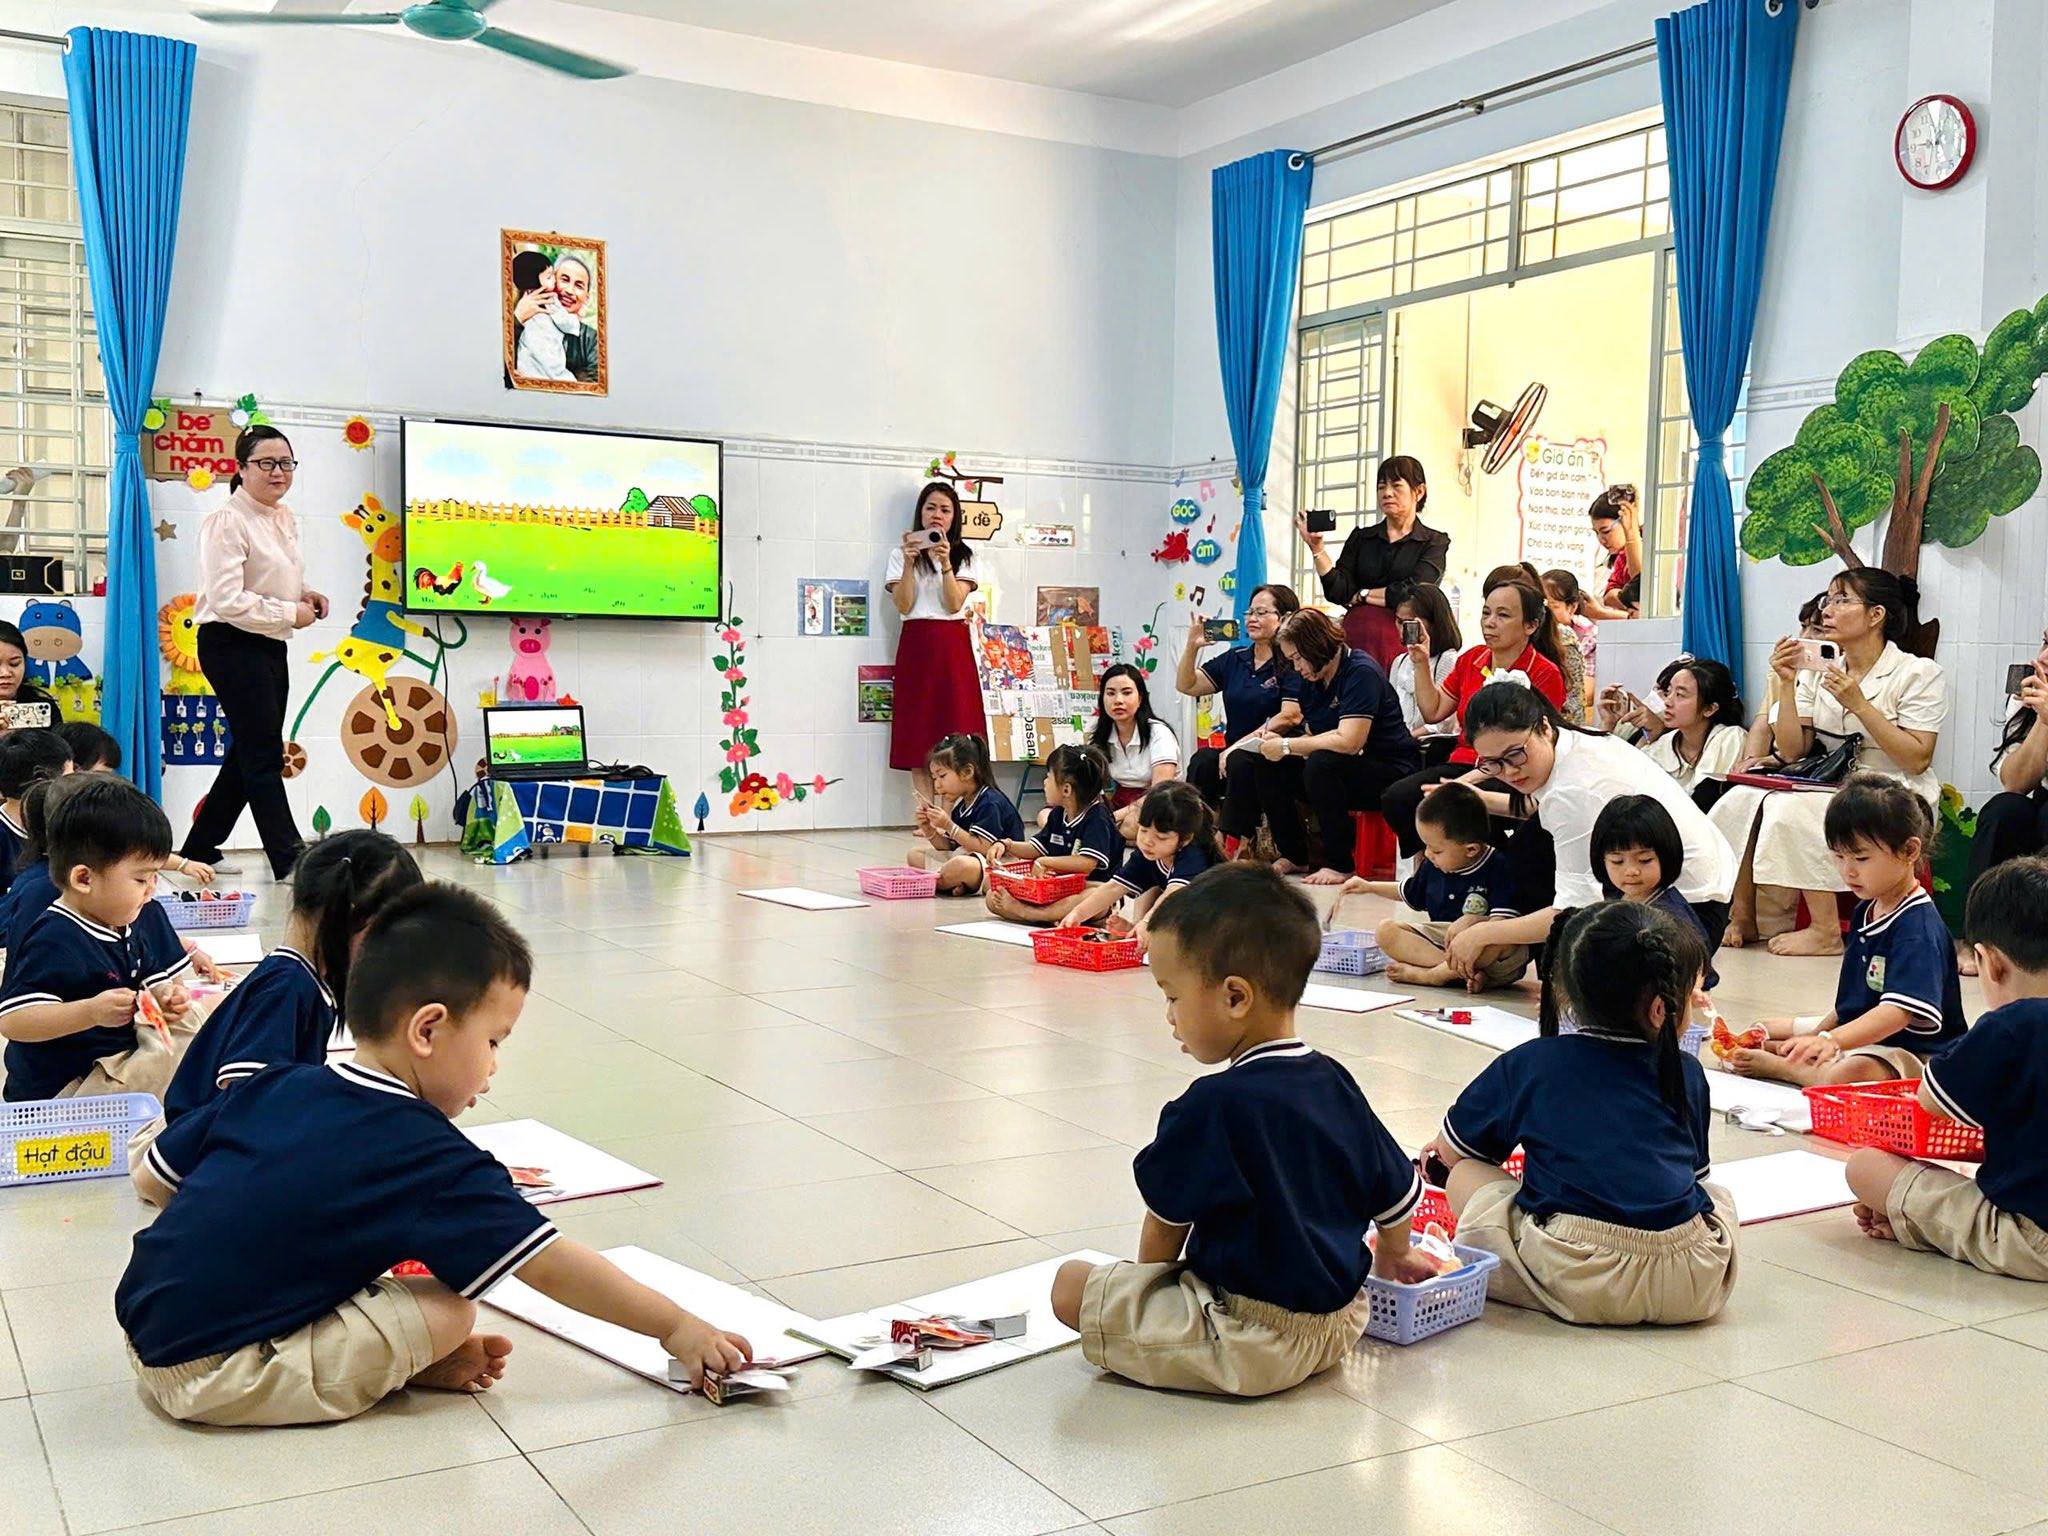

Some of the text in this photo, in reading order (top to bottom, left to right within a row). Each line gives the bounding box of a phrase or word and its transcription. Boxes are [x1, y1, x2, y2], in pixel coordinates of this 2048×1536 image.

[155, 431, 224, 453] chăm
[973, 511, 991, 527] đề
[24, 1141, 104, 1168] Hạt đậu
